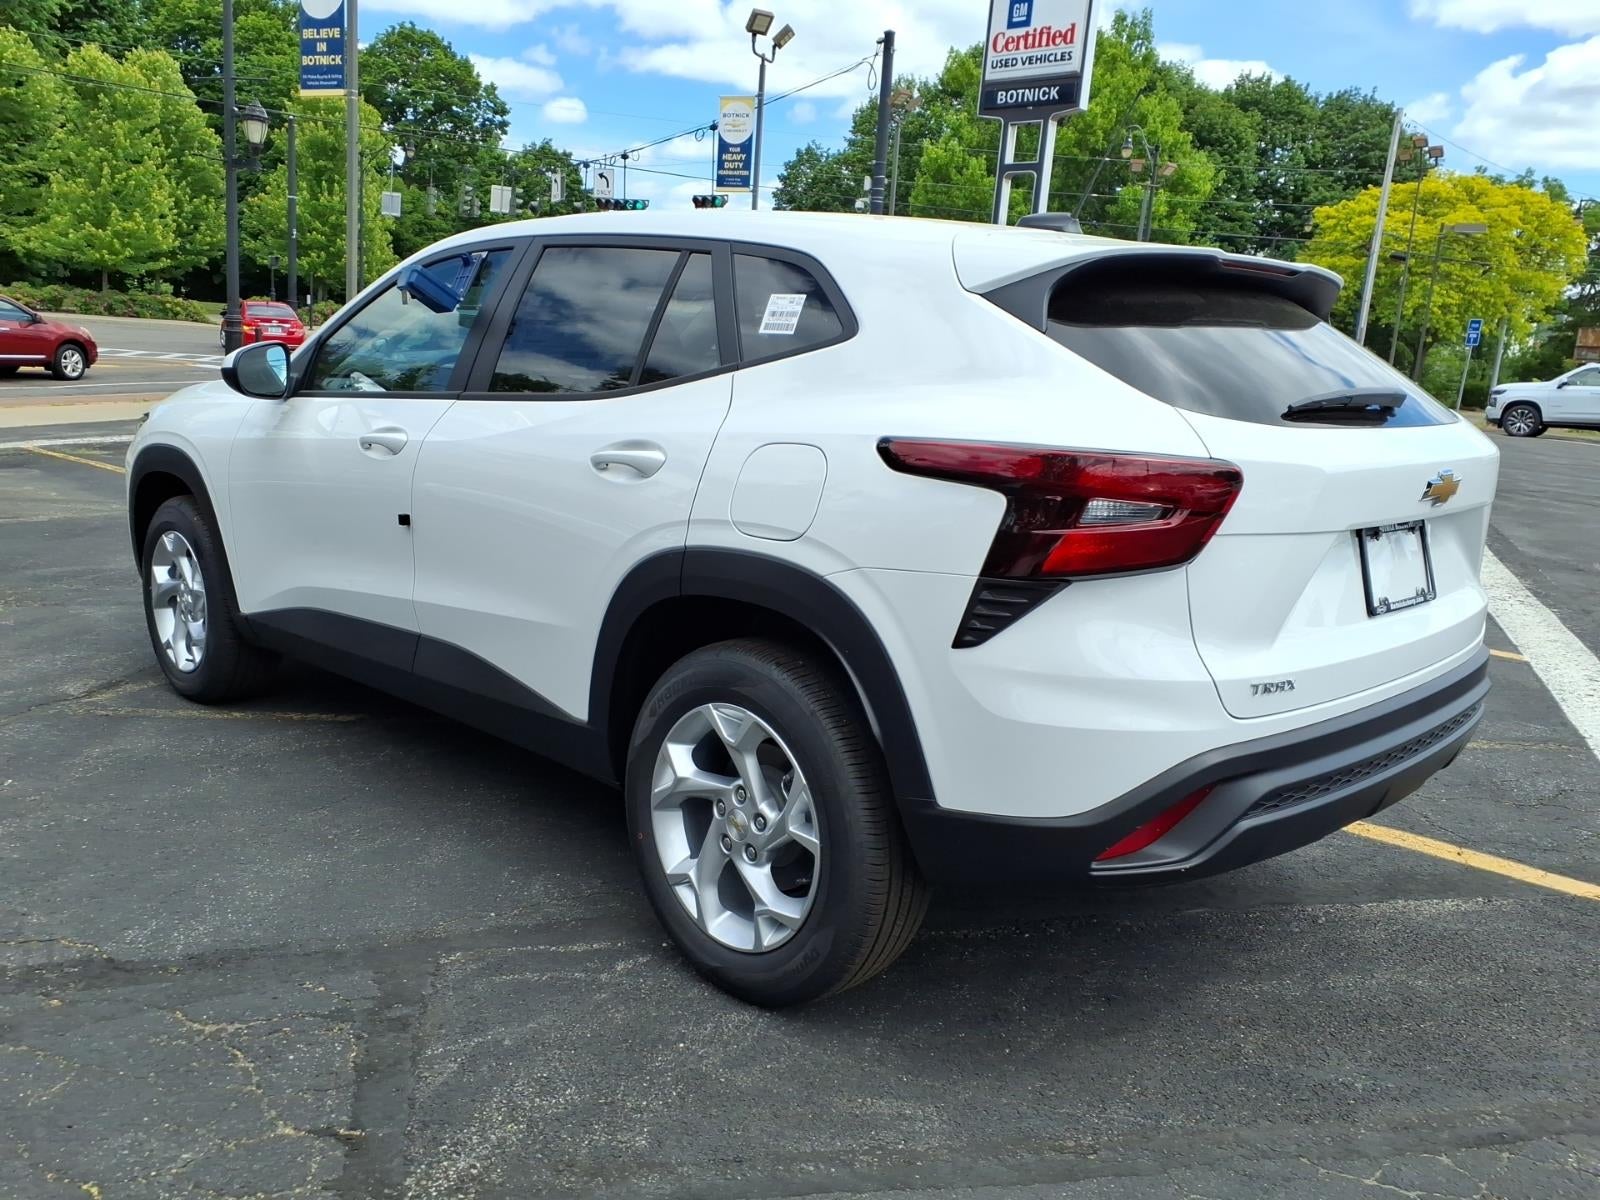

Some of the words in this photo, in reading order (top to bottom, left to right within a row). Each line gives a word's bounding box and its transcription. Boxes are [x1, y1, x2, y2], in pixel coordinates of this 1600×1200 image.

[1012, 2, 1028, 18] GM
[302, 27, 341, 39] BELIEVE
[992, 22, 1076, 54] Certified
[316, 41, 327, 52] IN
[301, 54, 342, 66] BOTNICK
[990, 57, 1018, 70] USED
[1020, 50, 1073, 67] VEHICLES
[997, 86, 1060, 105] BOTNICK
[722, 153, 747, 161] HEAVY
[724, 161, 744, 169] DUTY
